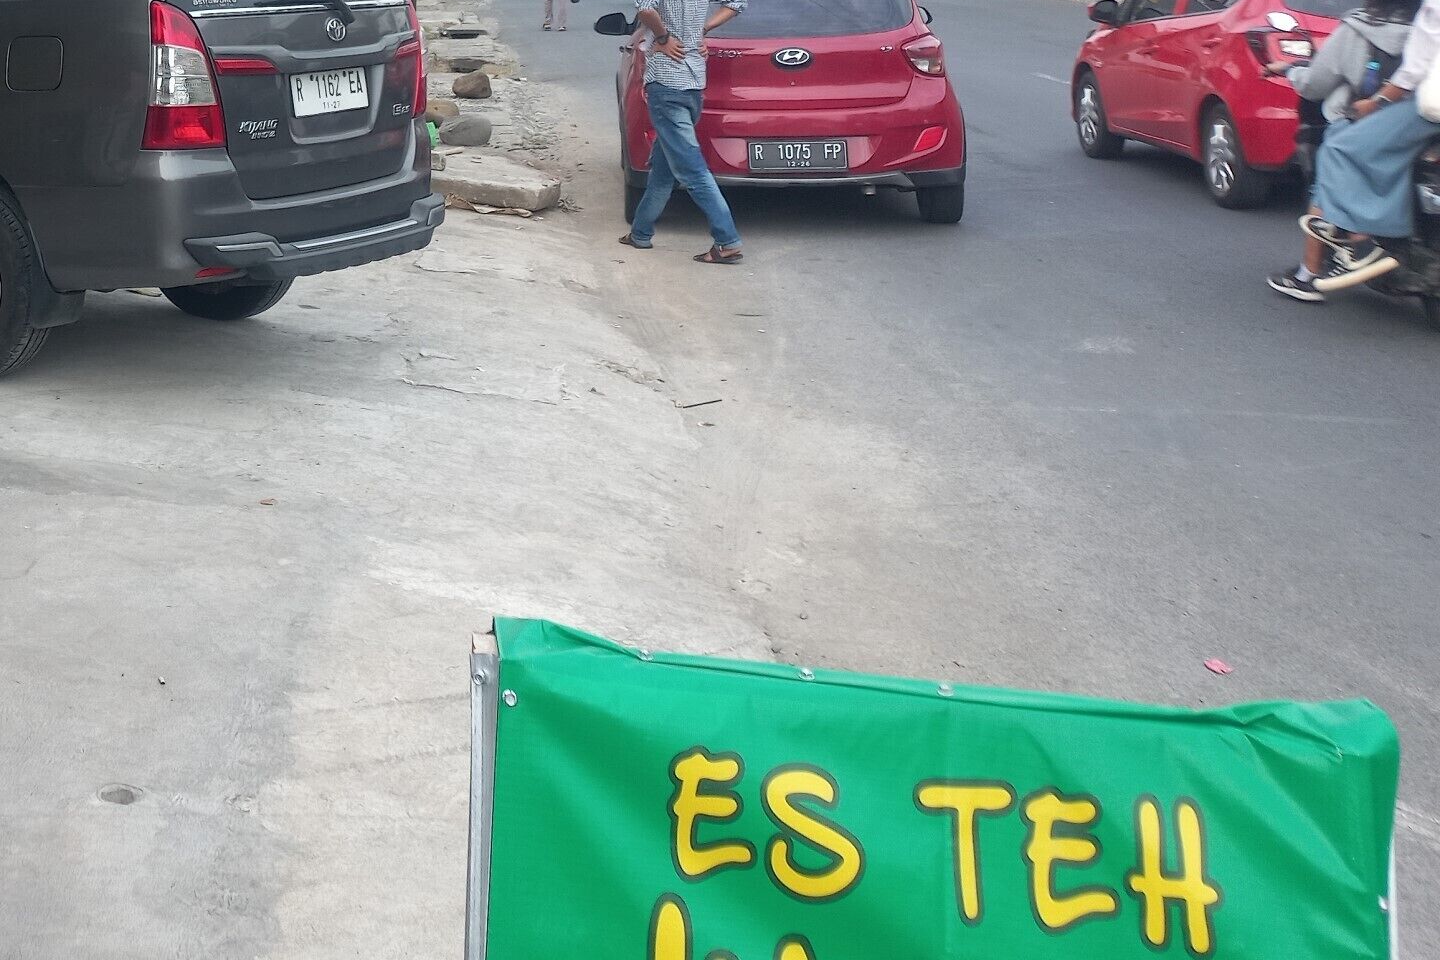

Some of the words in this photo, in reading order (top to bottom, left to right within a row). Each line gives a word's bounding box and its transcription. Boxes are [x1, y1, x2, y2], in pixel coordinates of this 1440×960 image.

[295, 76, 305, 102] R
[315, 72, 342, 99] 1162
[347, 70, 364, 94] EA
[238, 119, 279, 135] KIJANG
[754, 144, 764, 160] R
[777, 143, 812, 160] 1075
[823, 143, 842, 159] FP
[666, 746, 866, 904] ES
[910, 774, 1226, 958] TEH
